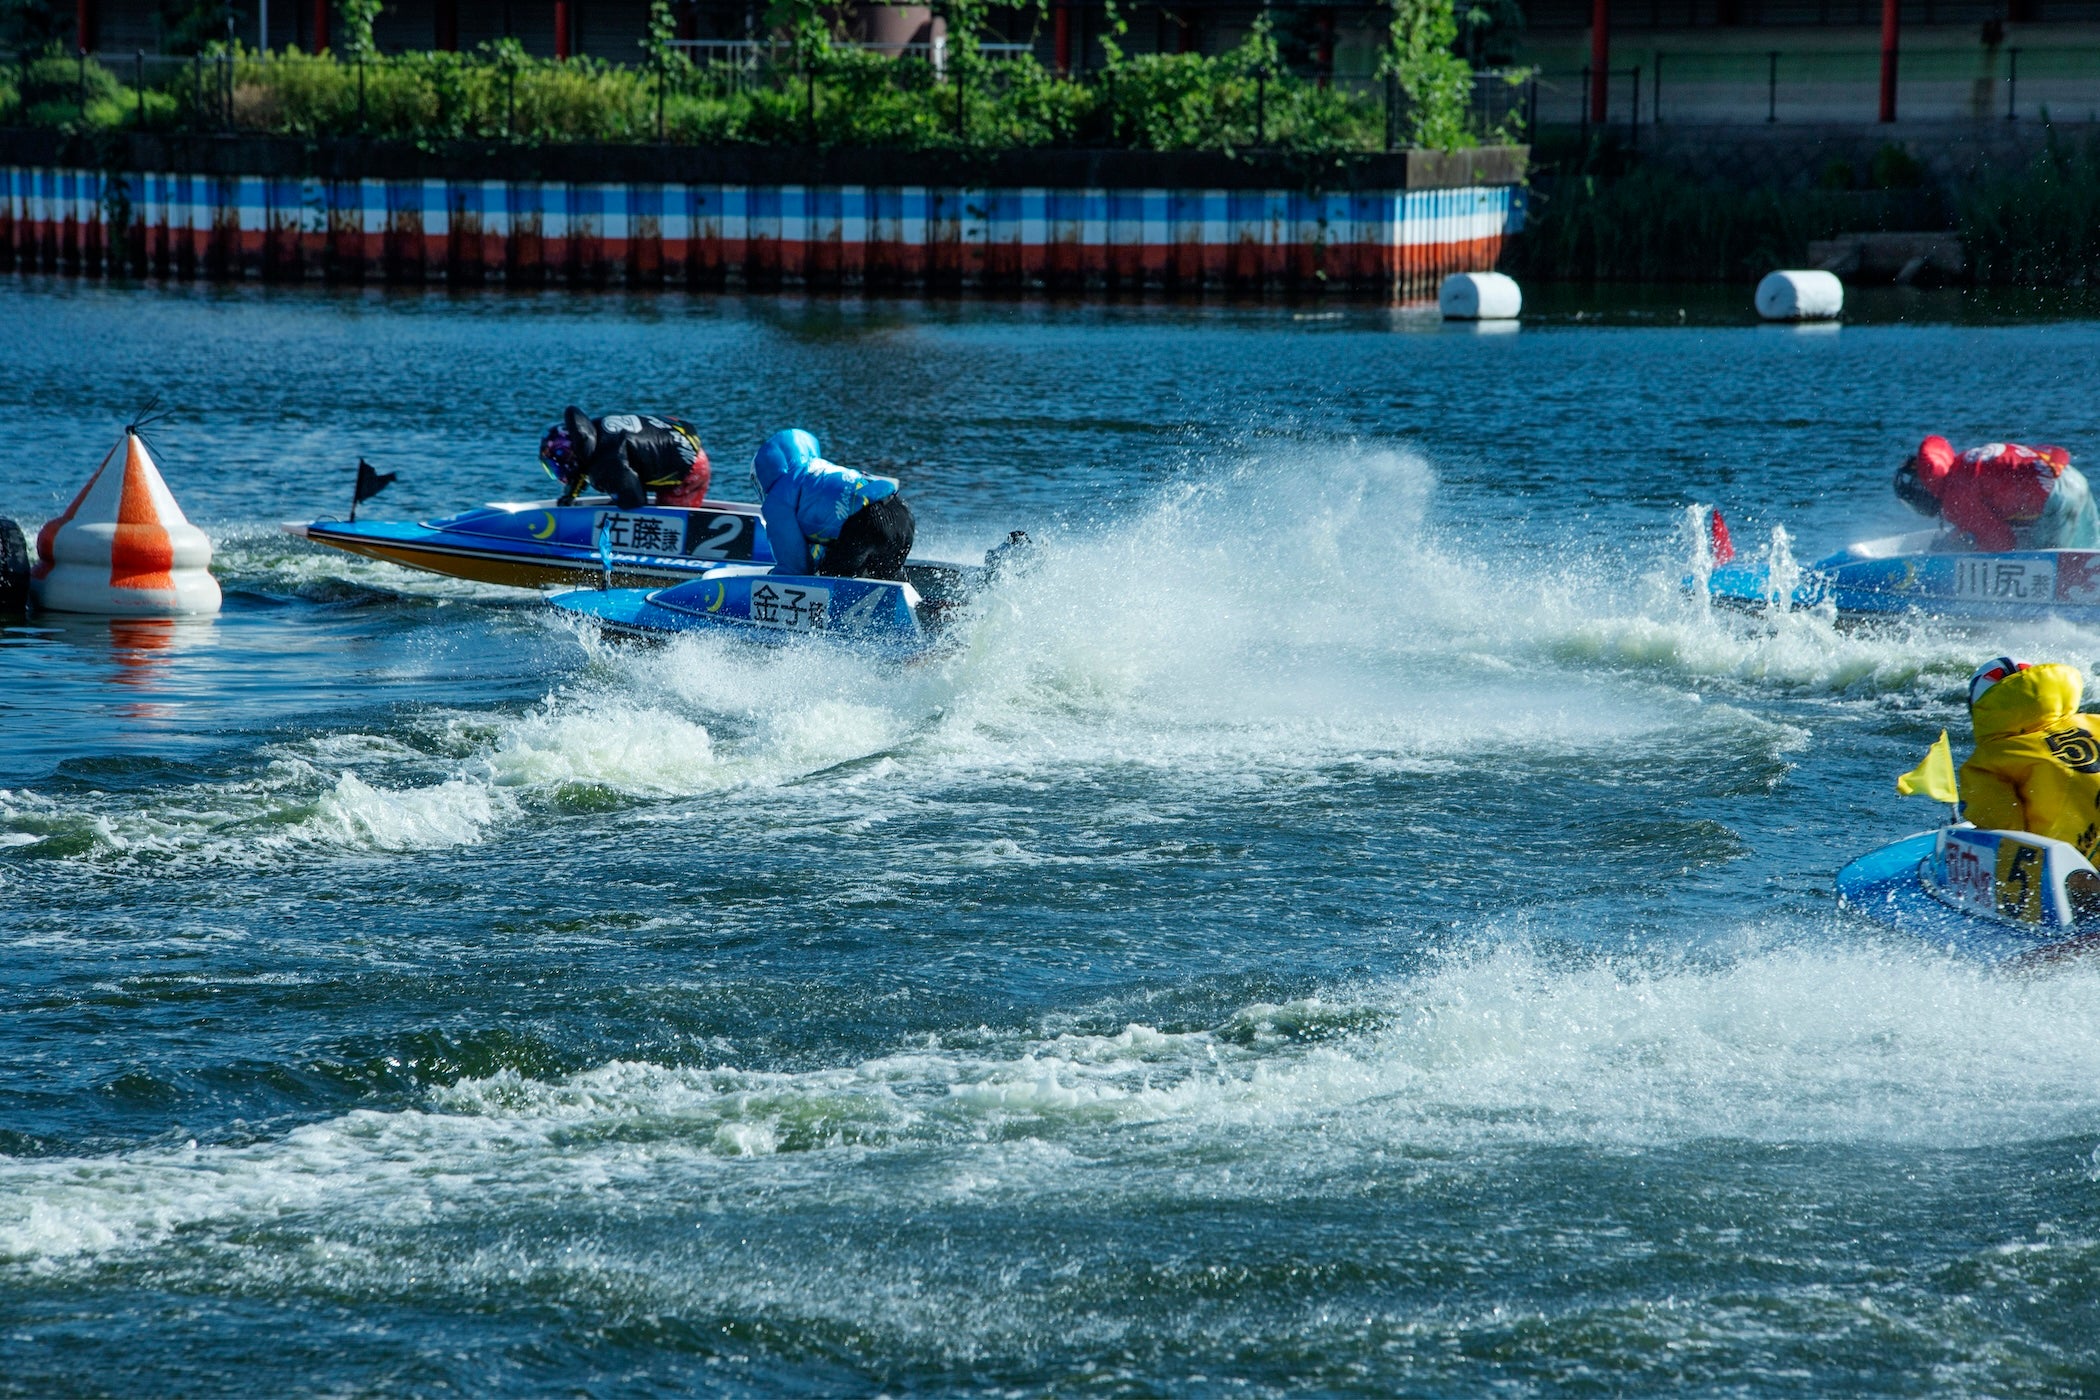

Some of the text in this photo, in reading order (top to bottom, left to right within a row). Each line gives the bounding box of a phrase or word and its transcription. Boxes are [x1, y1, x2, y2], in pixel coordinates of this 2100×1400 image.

[691, 515, 743, 559] 2
[842, 586, 888, 634] 4
[2045, 727, 2100, 773] 5
[2001, 846, 2038, 917] 5
